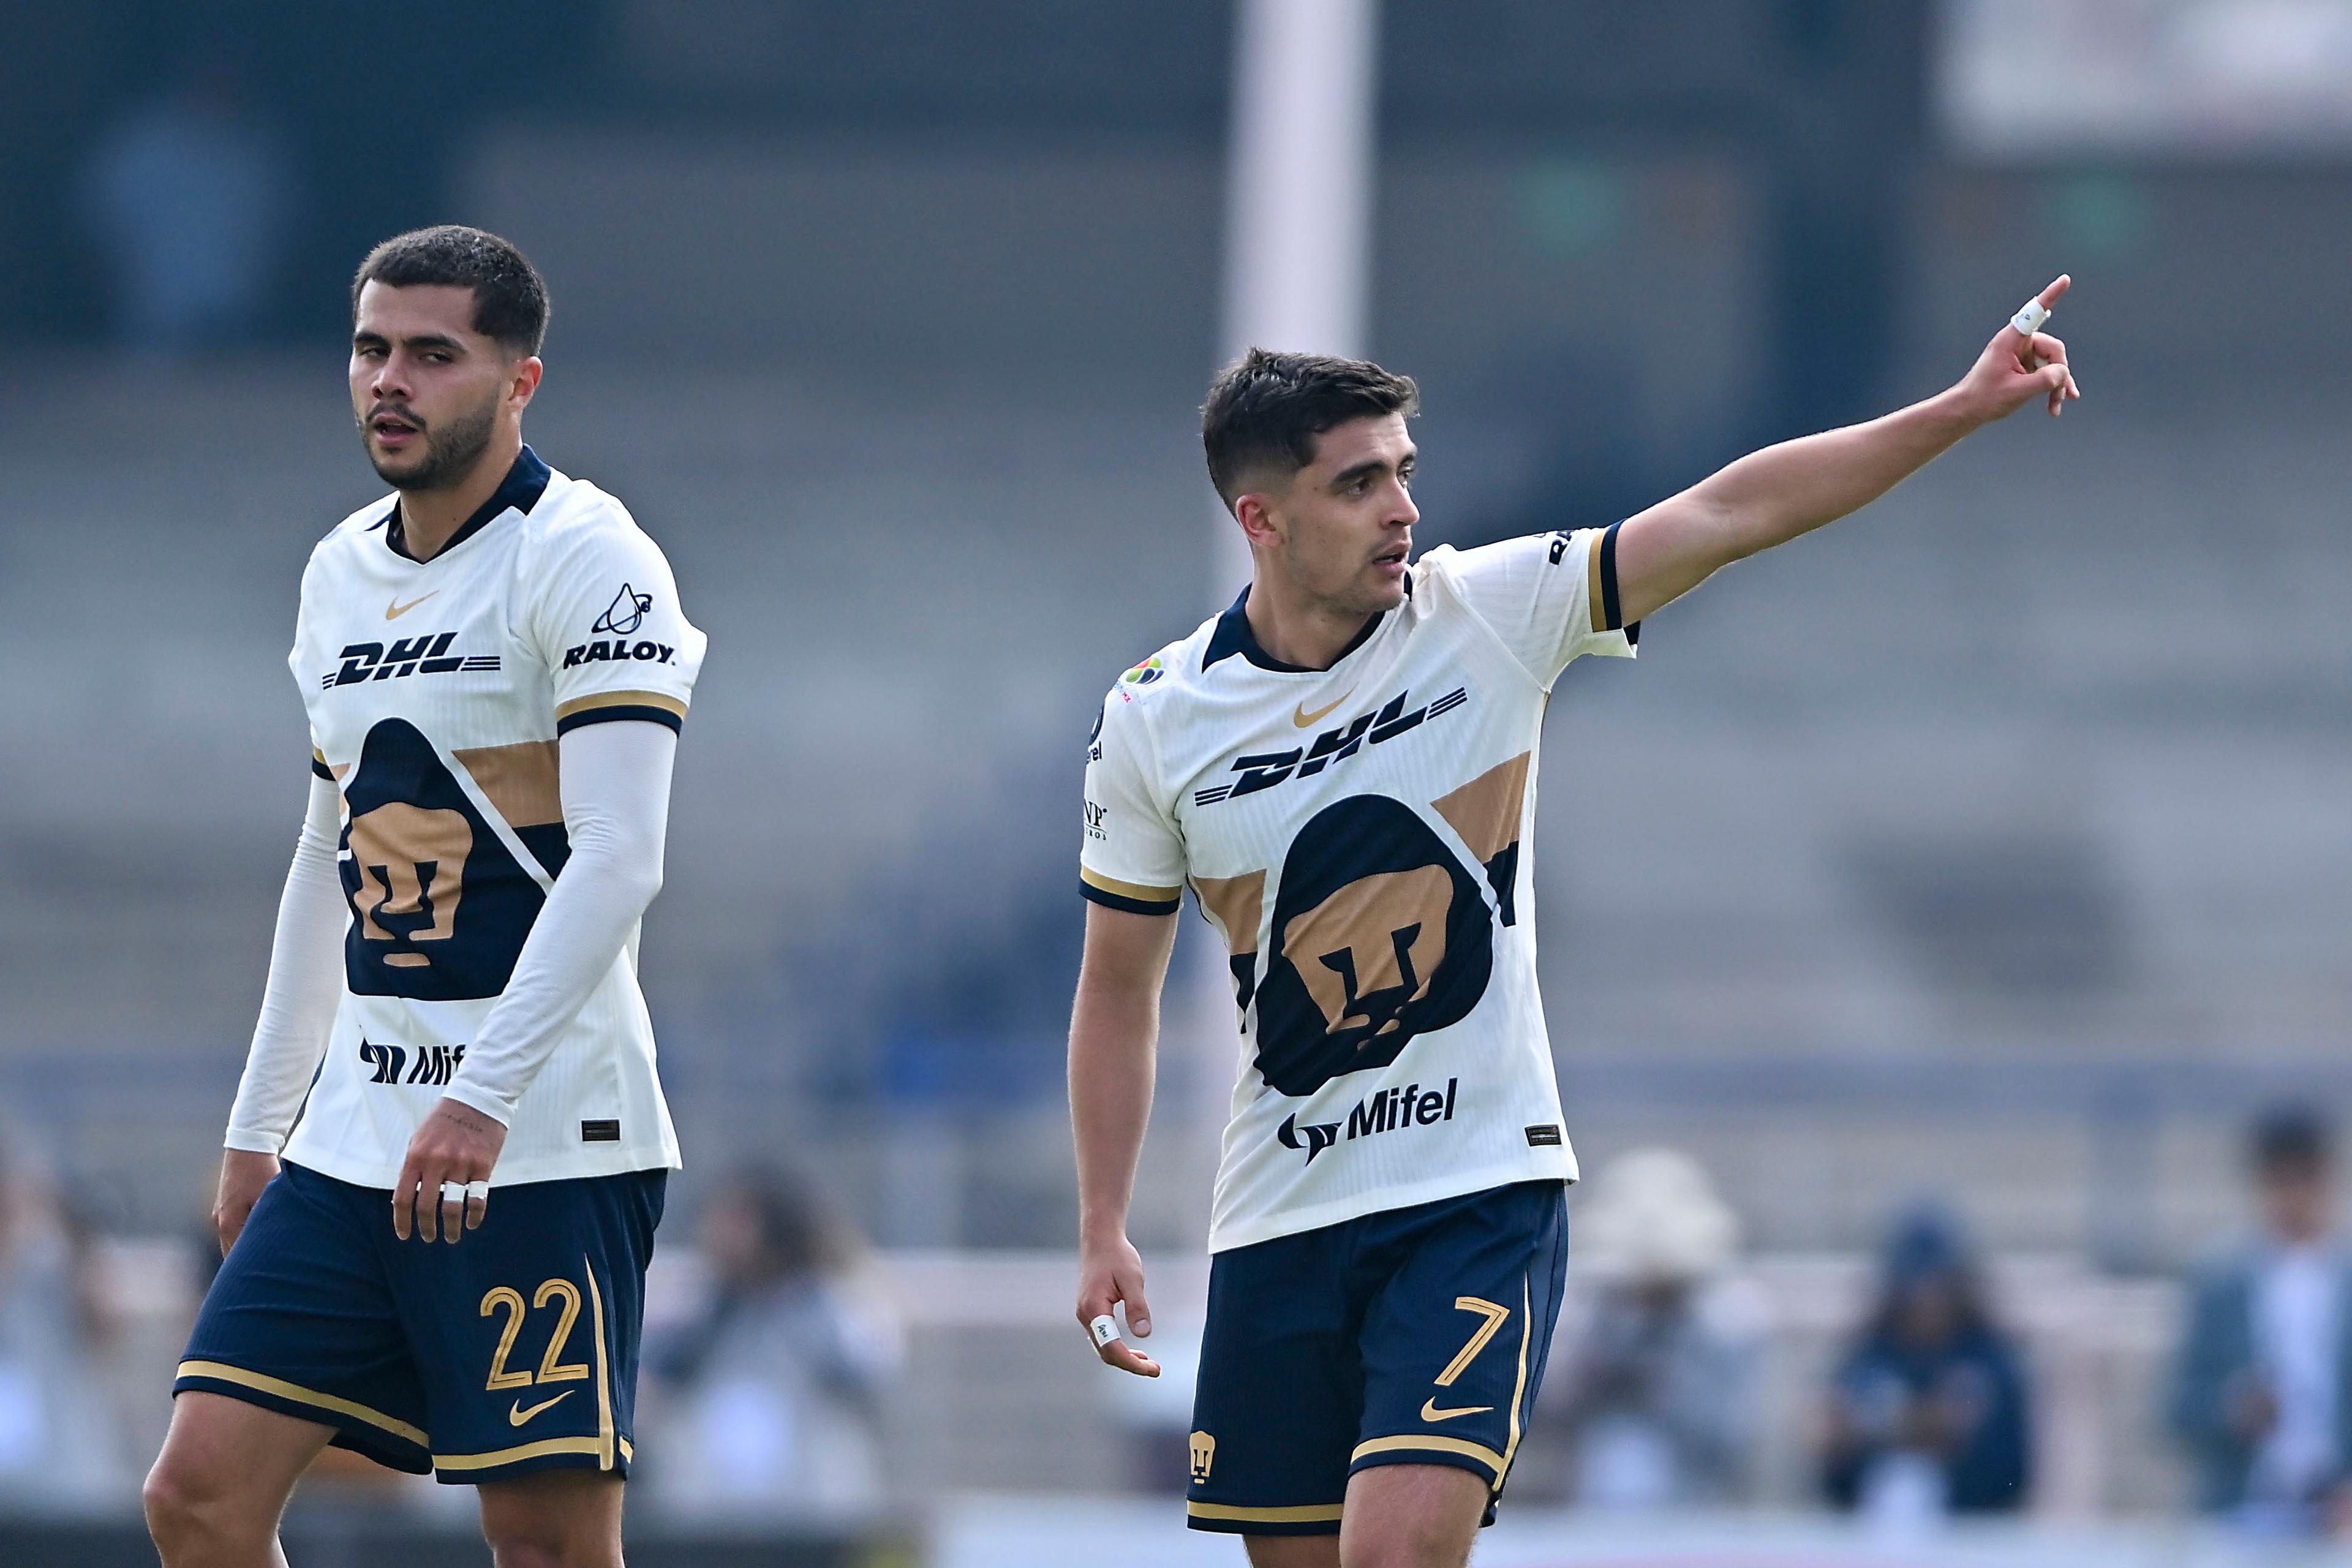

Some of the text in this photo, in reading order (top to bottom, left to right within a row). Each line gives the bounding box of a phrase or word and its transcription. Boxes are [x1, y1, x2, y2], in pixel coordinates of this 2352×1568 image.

[333, 631, 464, 687] DHL
[563, 639, 675, 670] RALOY
[1227, 688, 1428, 799] DHL
[1084, 798, 1102, 827] NP
[405, 1044, 467, 1086] Mif
[1347, 1076, 1458, 1140] Mifel
[480, 1278, 589, 1391] 22
[1433, 1296, 1510, 1387] 7
